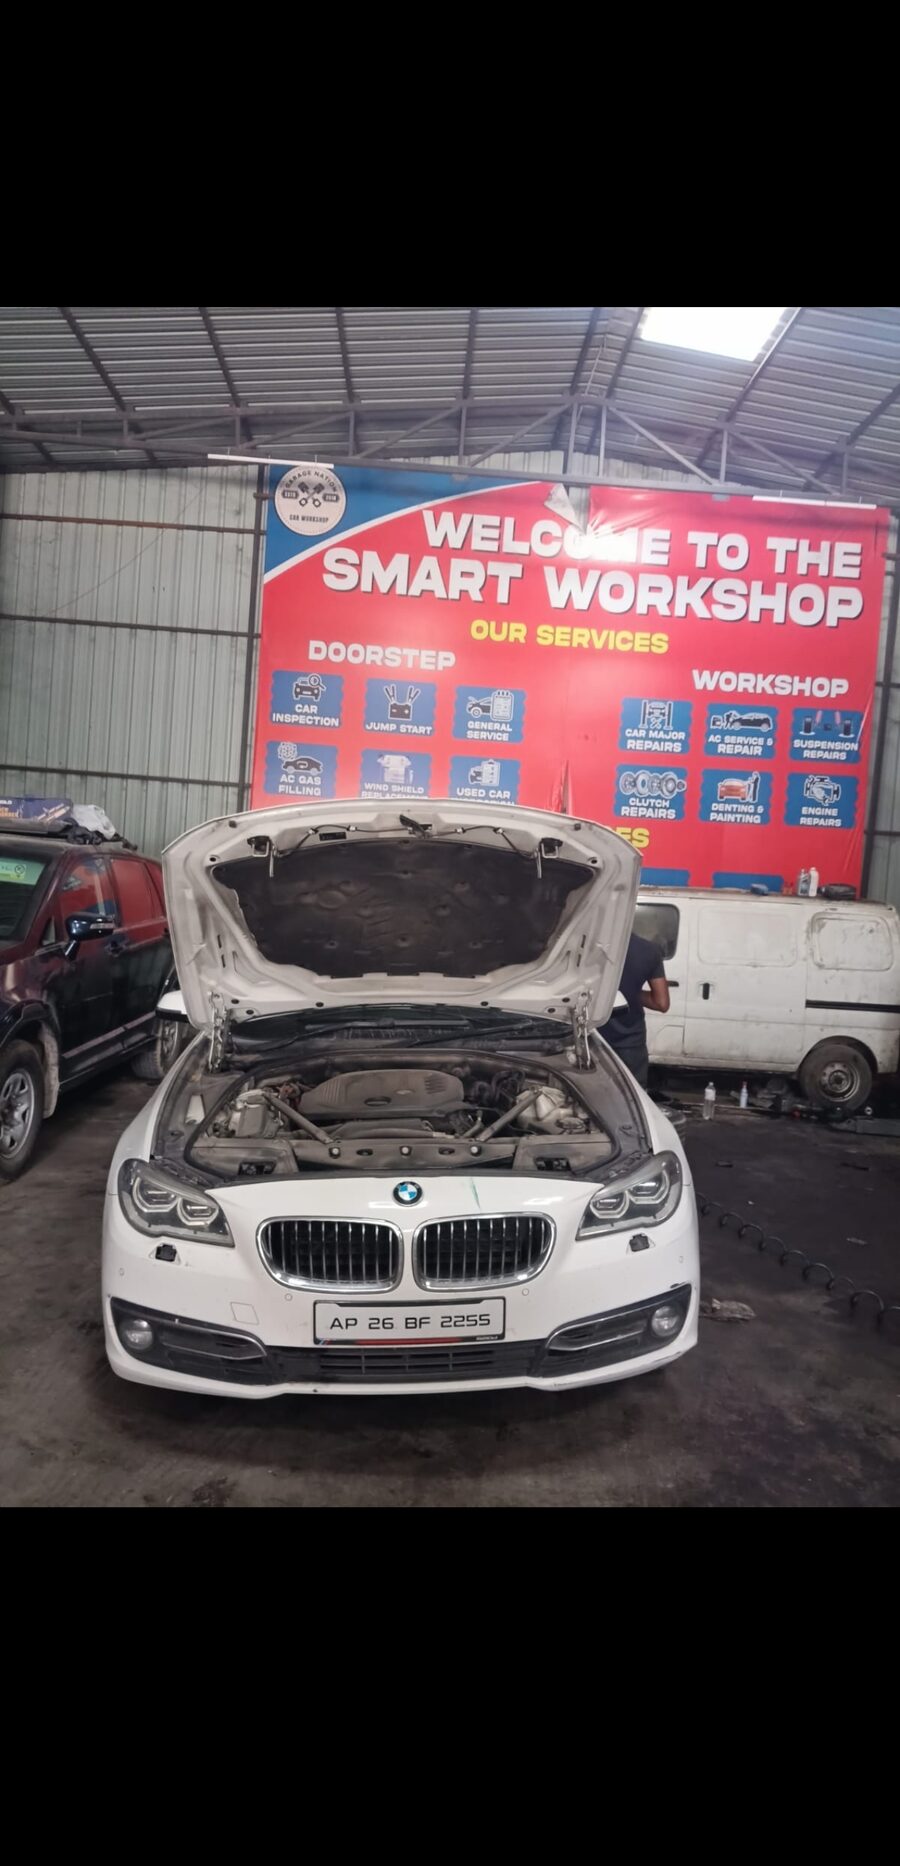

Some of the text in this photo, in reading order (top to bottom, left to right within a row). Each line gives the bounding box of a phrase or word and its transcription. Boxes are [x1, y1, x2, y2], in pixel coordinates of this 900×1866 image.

[286, 470, 337, 492] GARAGE NATION
[687, 530, 750, 571] TO
[767, 537, 863, 578] THE
[322, 548, 865, 628] SMART WORKSHOP
[470, 619, 669, 654] OUR SERVICES
[308, 640, 456, 671] DOORSTEP
[692, 669, 849, 698] WORKSHOP
[295, 704, 318, 714] CAR
[272, 713, 339, 727] INSPECTION
[366, 722, 432, 735] JUMP START
[467, 721, 512, 732] GENERAL
[467, 731, 509, 742] SERVICE
[625, 729, 685, 740] CAR MAJOR
[708, 735, 722, 743] AC
[725, 735, 764, 745] SERVICE
[627, 740, 682, 752] REPAIRS
[717, 744, 762, 755] REPAIR
[793, 739, 859, 751] SUSPENSION
[803, 750, 847, 760] REPAIRS
[280, 775, 321, 785] AC GAS
[278, 785, 321, 796] FILLING
[364, 783, 424, 794] WIND SHIELD
[457, 787, 511, 798] USED CAR
[629, 797, 670, 807] CLUTCH
[621, 807, 676, 819] REPAIRS
[712, 803, 755, 813] DENTING
[801, 807, 838, 816] ENGINE
[710, 812, 761, 824] PAINTING
[800, 817, 842, 827] REPAIRS
[330, 1314, 490, 1330] AP 26 BF 2255
